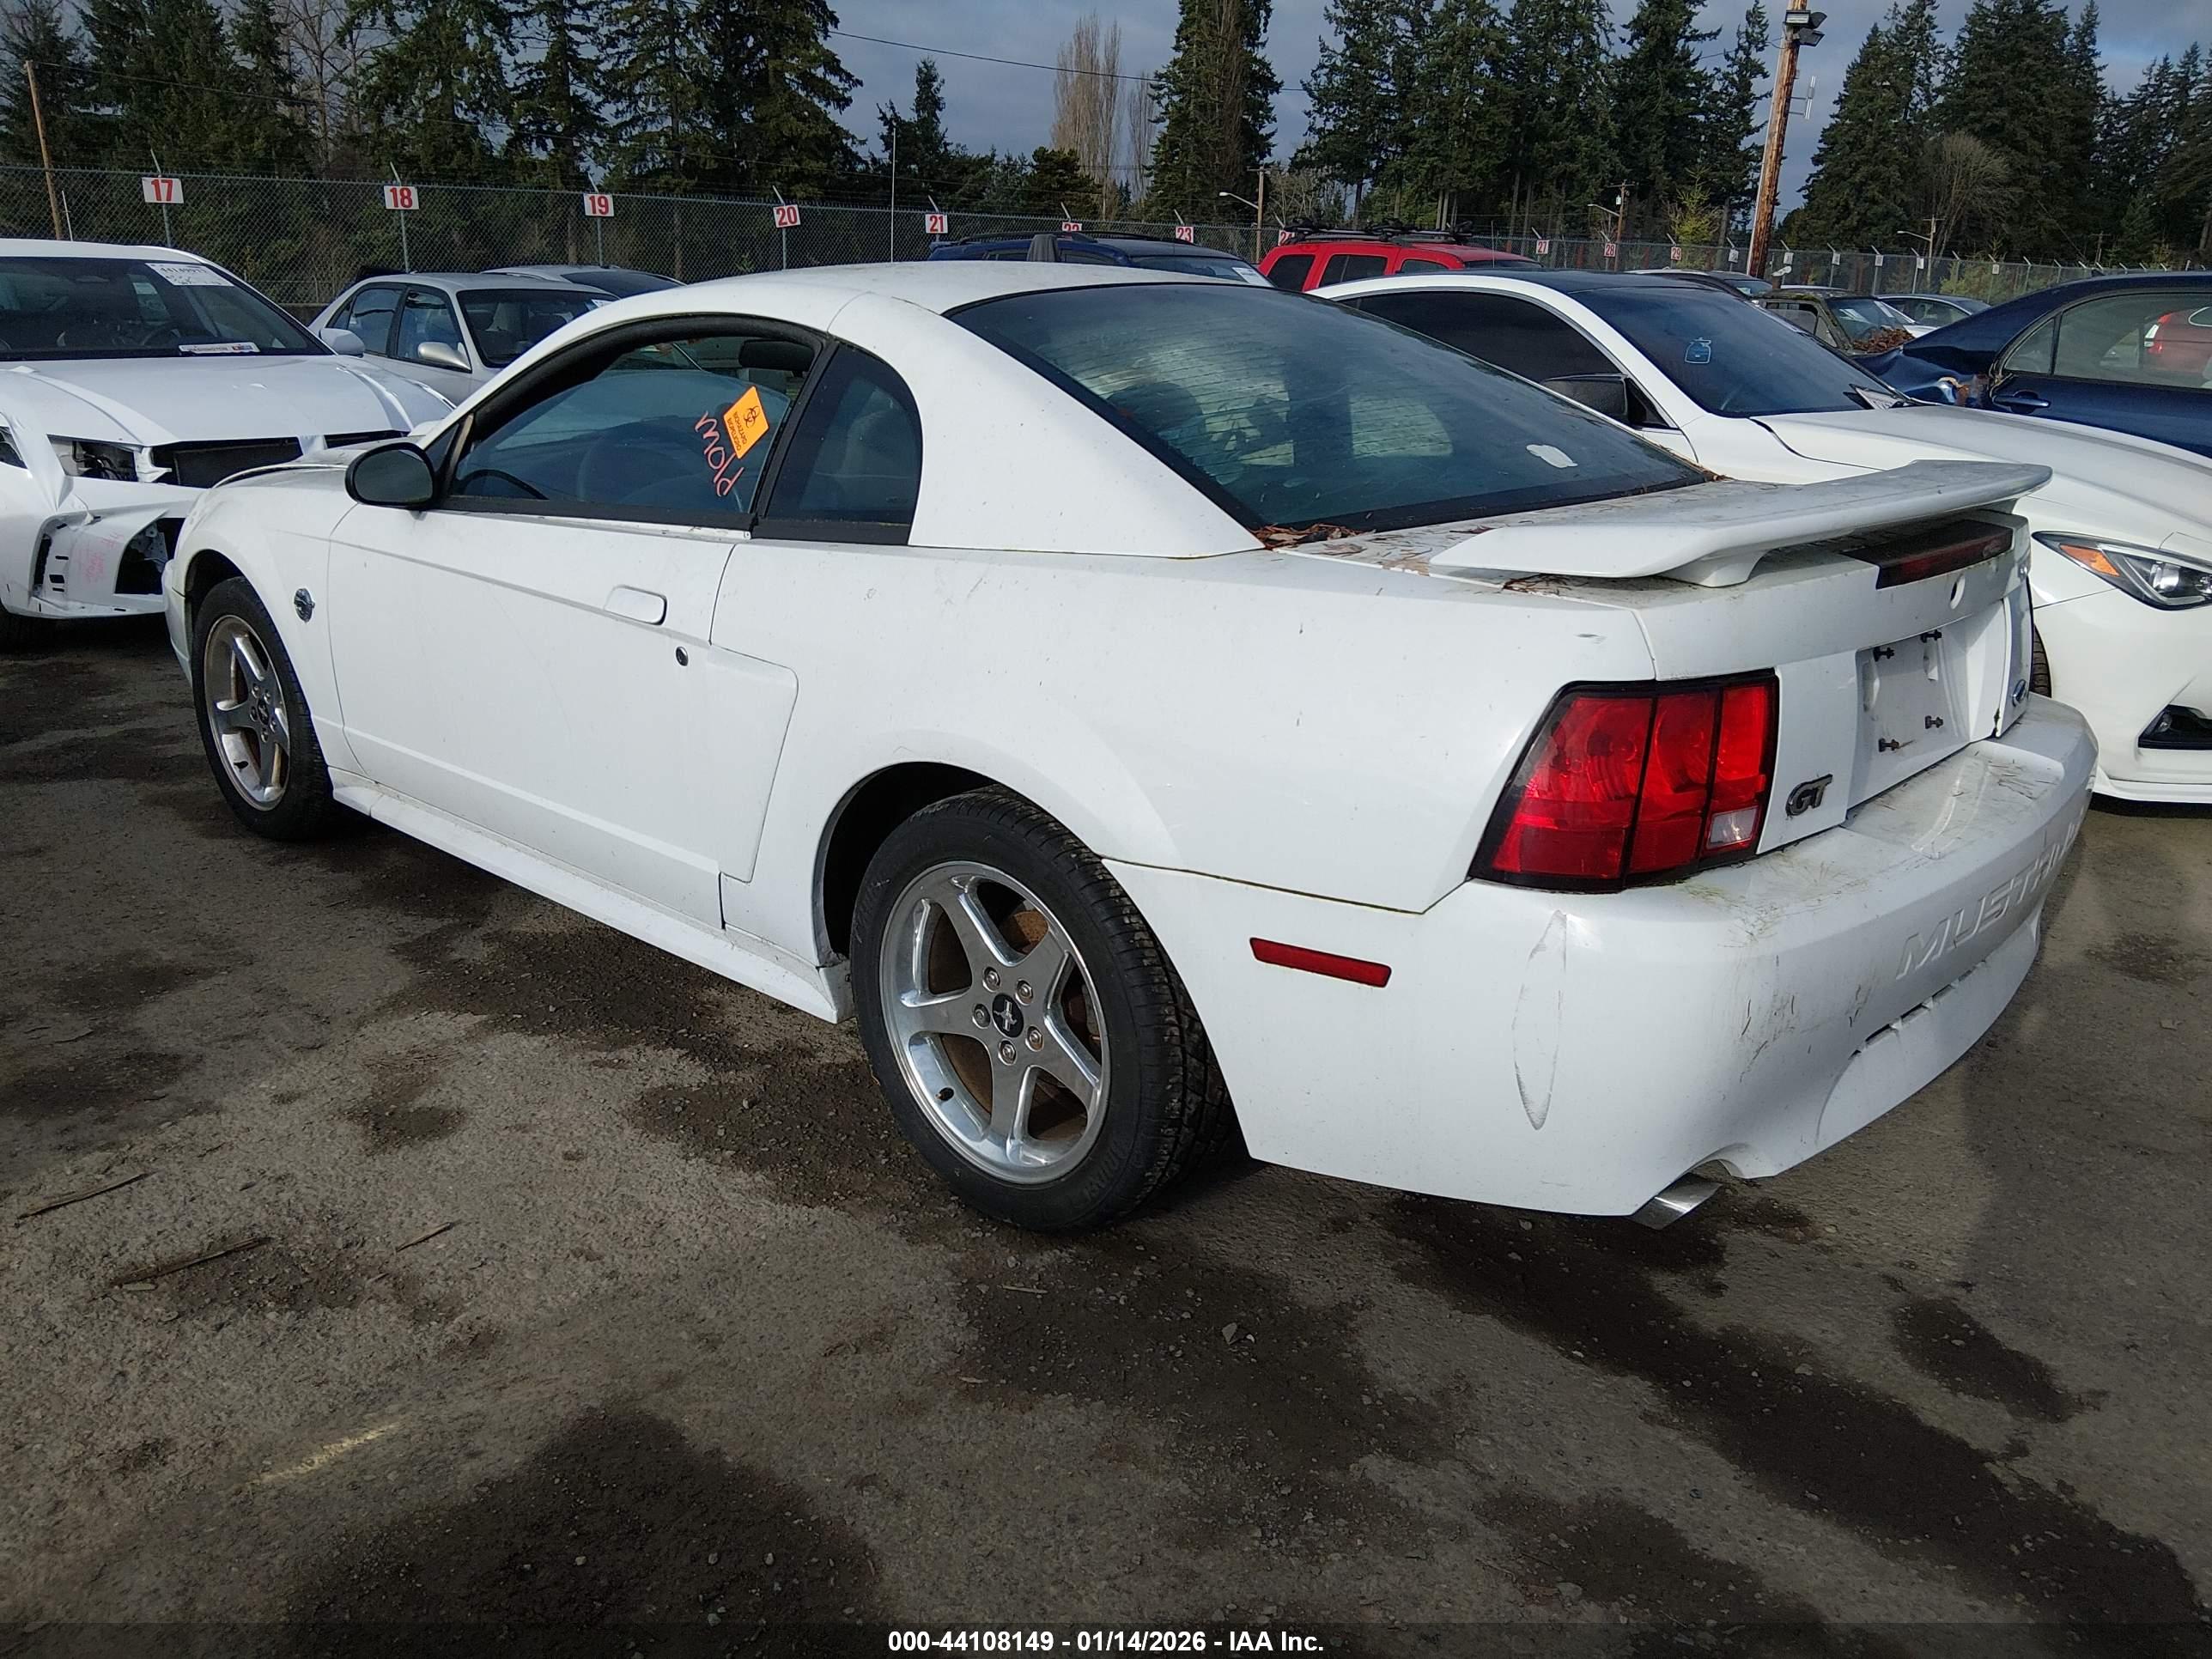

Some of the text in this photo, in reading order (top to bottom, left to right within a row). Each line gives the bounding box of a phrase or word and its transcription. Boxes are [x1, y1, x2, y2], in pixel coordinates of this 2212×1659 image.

[150, 178, 173, 203] 17
[389, 186, 413, 210] 18
[589, 195, 609, 216] 19
[775, 205, 798, 227] 20
[929, 215, 944, 233] 21
[1177, 227, 1192, 242] 23
[1537, 240, 1547, 253] 27
[1606, 244, 1615, 256] 28
[1672, 246, 1681, 259] 29
[1785, 771, 1834, 817] GT
